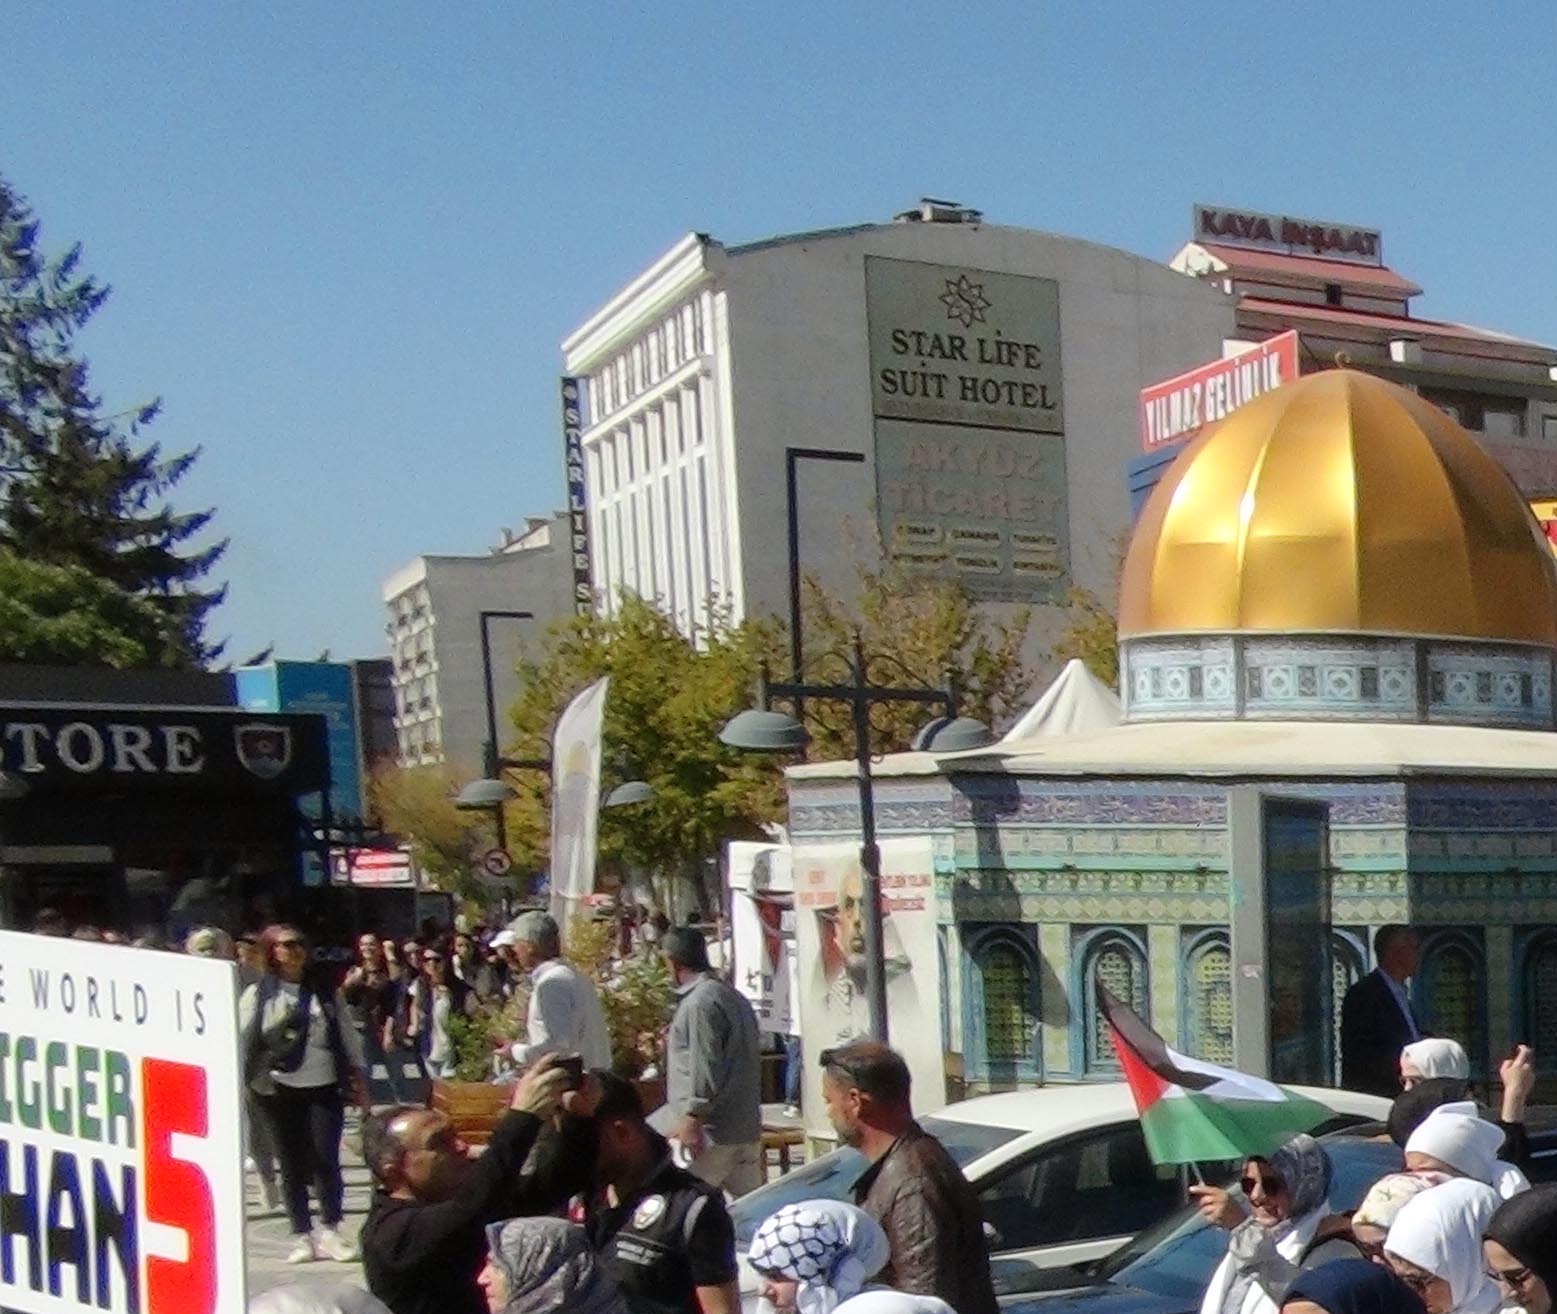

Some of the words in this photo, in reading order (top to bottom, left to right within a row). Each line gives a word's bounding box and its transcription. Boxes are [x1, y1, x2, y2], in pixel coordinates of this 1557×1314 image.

[1201, 209, 1276, 241] KAYA
[1281, 216, 1379, 256] İNŞAAT
[891, 328, 968, 362] STAR
[977, 330, 1042, 370] LİFE
[880, 360, 948, 398] SUİT
[958, 375, 1058, 410] HOTEL
[1145, 381, 1202, 444] YILMAZ
[0, 722, 207, 774] TORE
[29, 966, 149, 1026] WORLD
[174, 988, 208, 1037] IS
[0, 1030, 137, 1150] GGER
